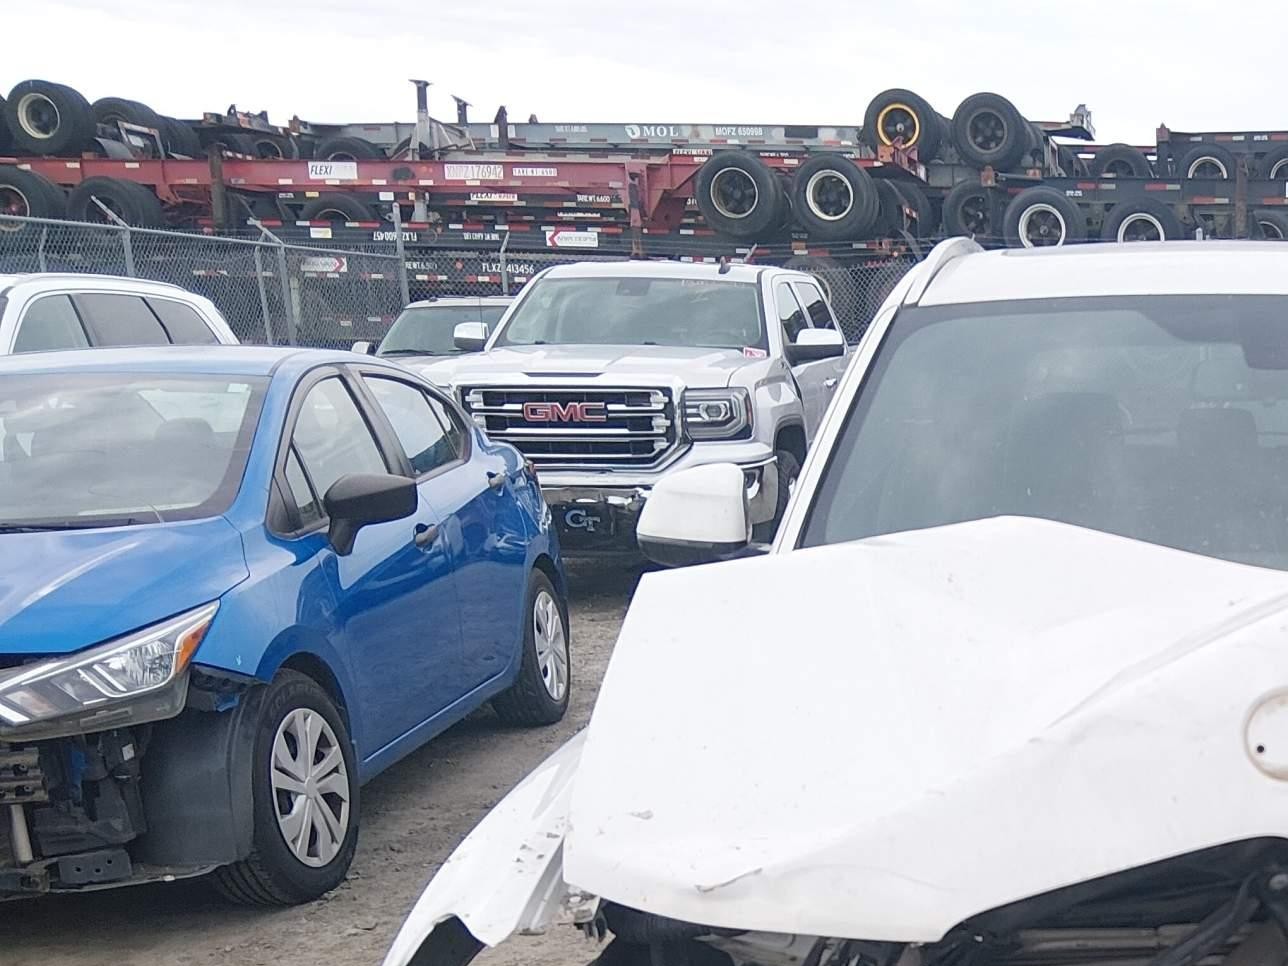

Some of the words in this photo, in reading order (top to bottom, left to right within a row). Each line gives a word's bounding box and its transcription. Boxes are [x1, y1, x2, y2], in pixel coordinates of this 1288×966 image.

[643, 125, 679, 138] MOL
[310, 165, 333, 177] FLEXI
[482, 263, 502, 273] FLXZ
[506, 263, 535, 274] 413456
[523, 402, 606, 422] GMC
